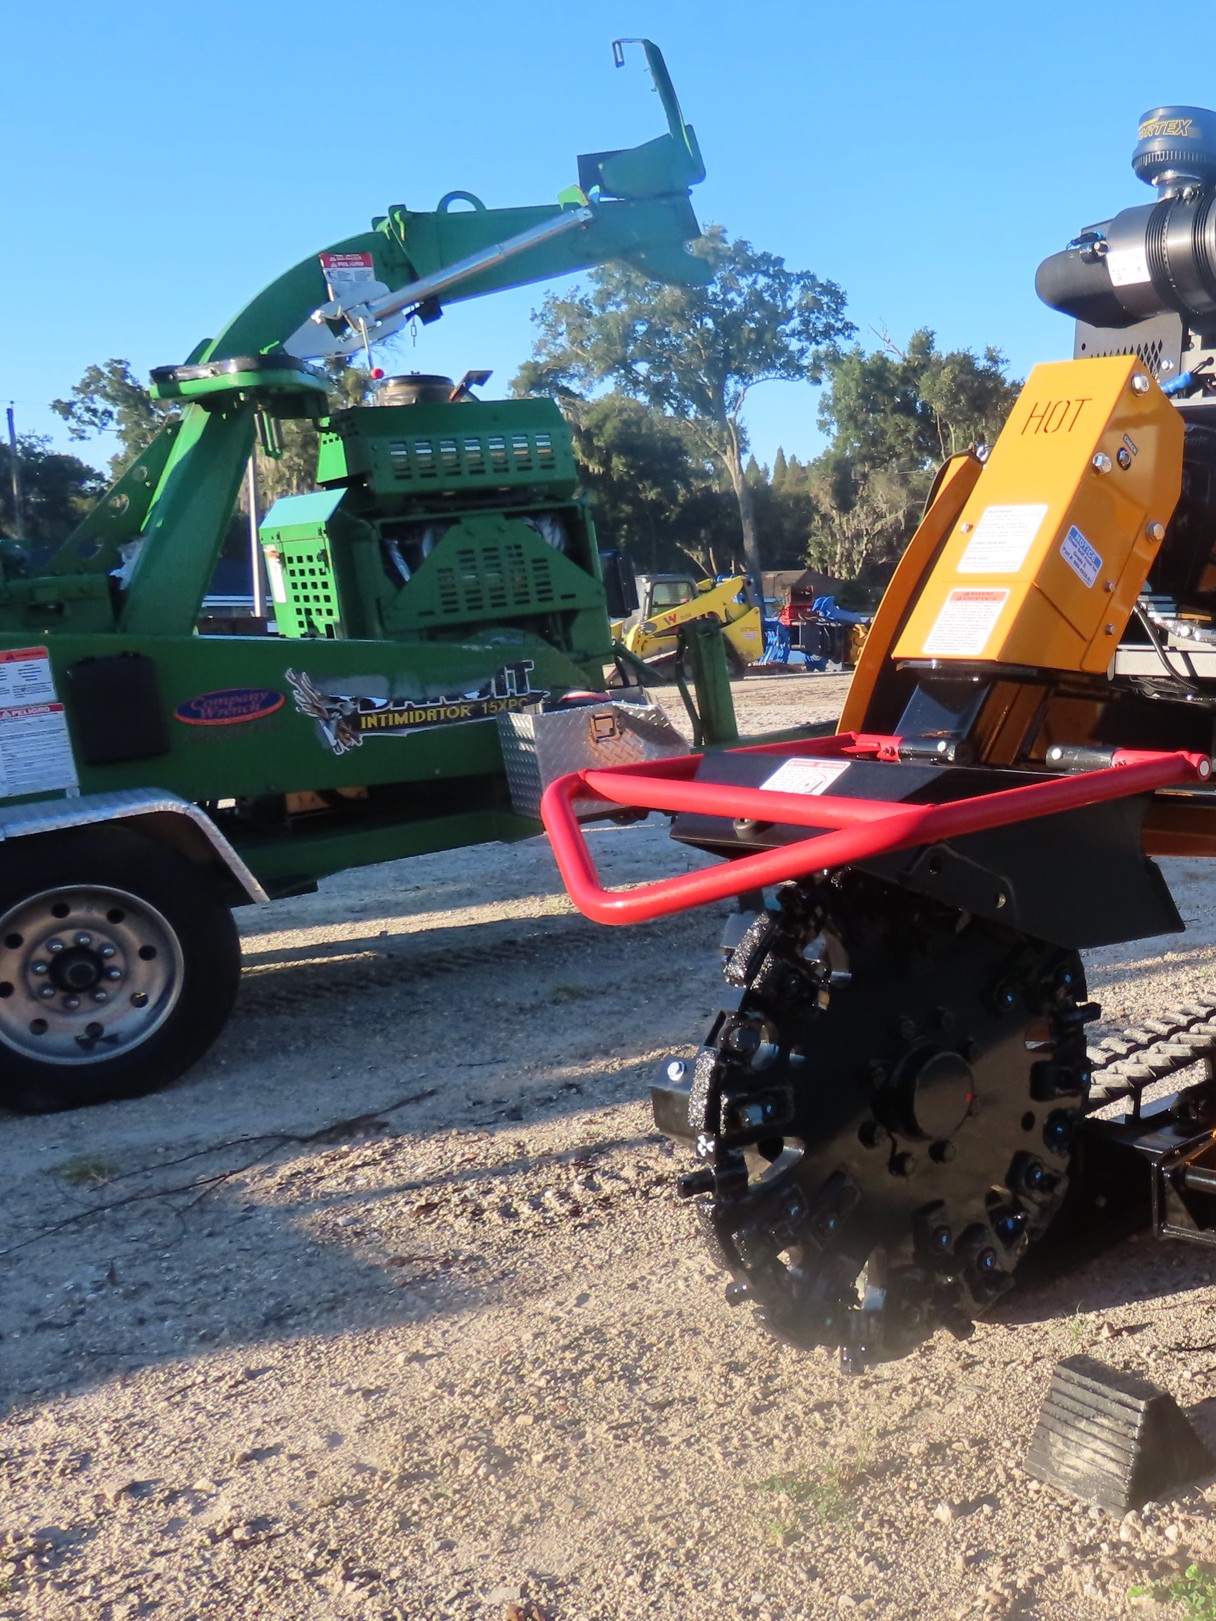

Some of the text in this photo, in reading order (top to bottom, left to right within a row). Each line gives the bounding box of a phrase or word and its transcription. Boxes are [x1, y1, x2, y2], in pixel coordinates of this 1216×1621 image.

[1020, 398, 1094, 436] HOT
[1074, 532, 1097, 562] NOTICE
[11, 705, 51, 717] PELIGRO
[190, 691, 270, 710] Company
[200, 703, 261, 719] Wrench
[360, 705, 472, 729] INTIMIDATOR
